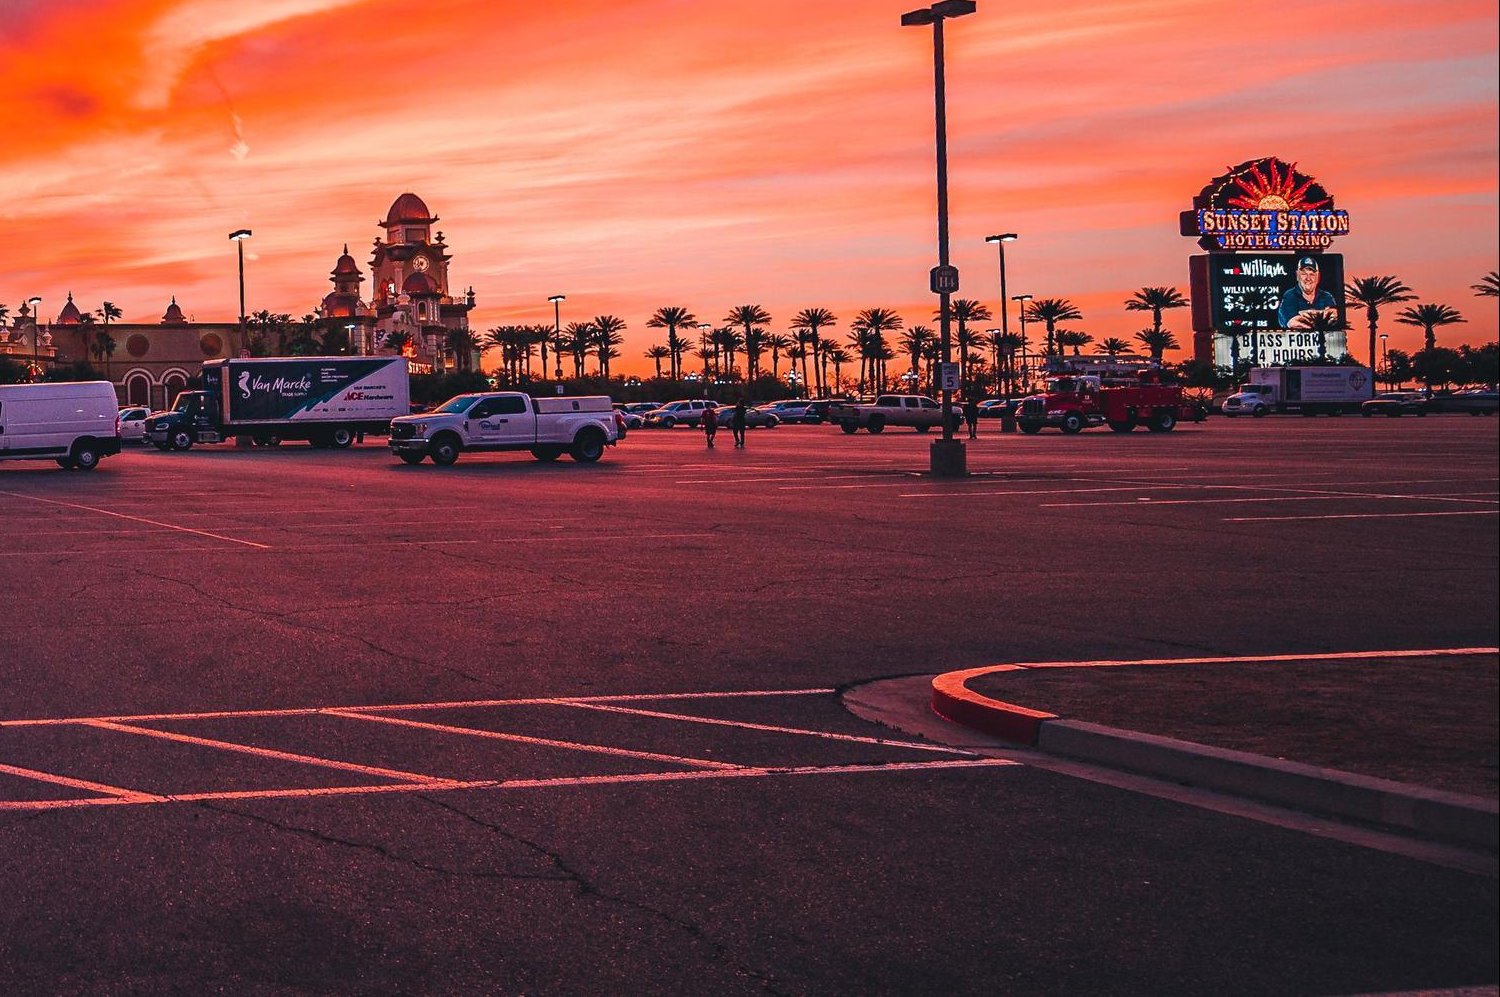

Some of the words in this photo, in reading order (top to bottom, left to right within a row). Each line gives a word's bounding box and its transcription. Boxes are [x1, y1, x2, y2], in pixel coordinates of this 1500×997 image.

[1203, 210, 1273, 231] SUNSET
[1276, 210, 1349, 231] STATION
[1241, 259, 1288, 277] William
[1243, 334, 1283, 347] BASS
[1289, 334, 1321, 347] FORK
[1273, 349, 1314, 362] HOURS
[252, 375, 270, 393] Van
[272, 376, 312, 394] Marcke
[946, 377, 954, 388] 5
[343, 392, 364, 401] ACE
